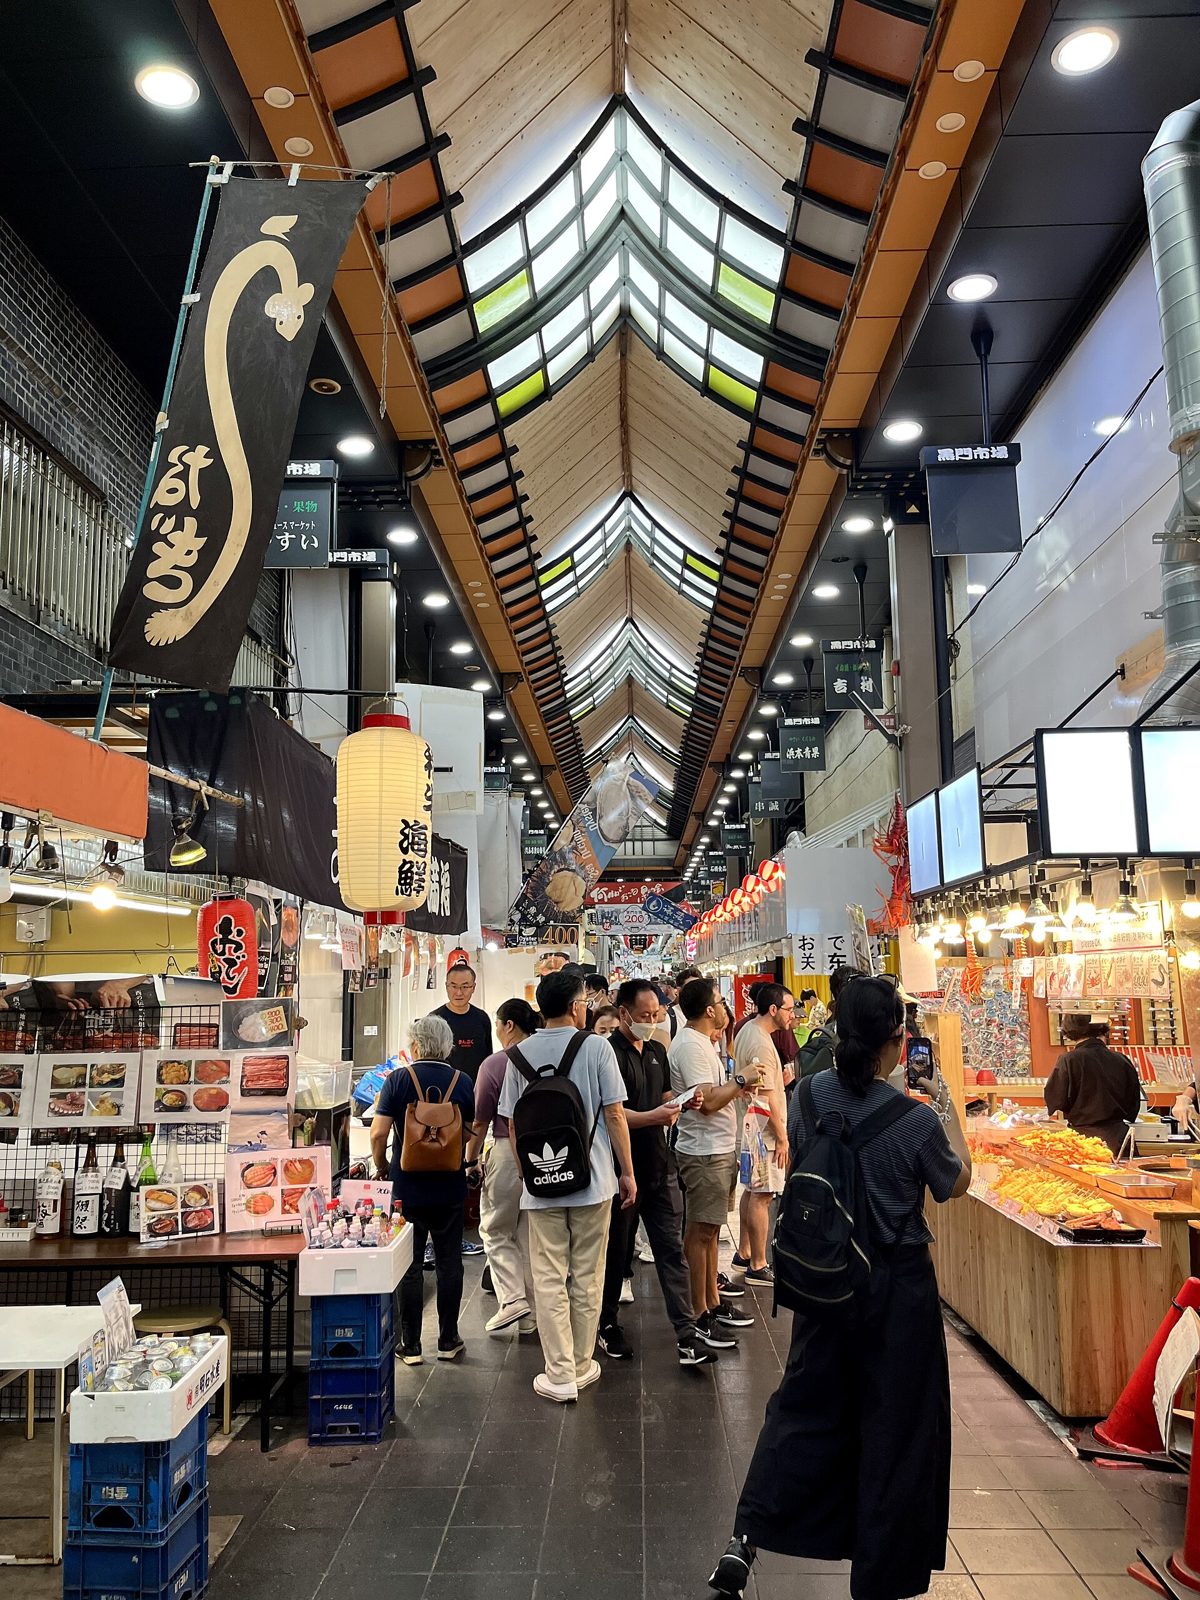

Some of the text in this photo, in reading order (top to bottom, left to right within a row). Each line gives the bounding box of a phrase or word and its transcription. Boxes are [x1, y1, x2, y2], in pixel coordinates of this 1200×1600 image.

[937, 446, 1008, 461] 黒門市場
[286, 463, 320, 475] 市場
[269, 531, 319, 551] すい
[830, 640, 876, 650] 黒門市場
[786, 746, 820, 759] 浜本青果
[394, 819, 428, 898] 海鮮
[625, 915, 645, 923] 200
[543, 926, 578, 945] 400
[209, 915, 248, 997] おでん
[533, 1169, 574, 1186] adidas
